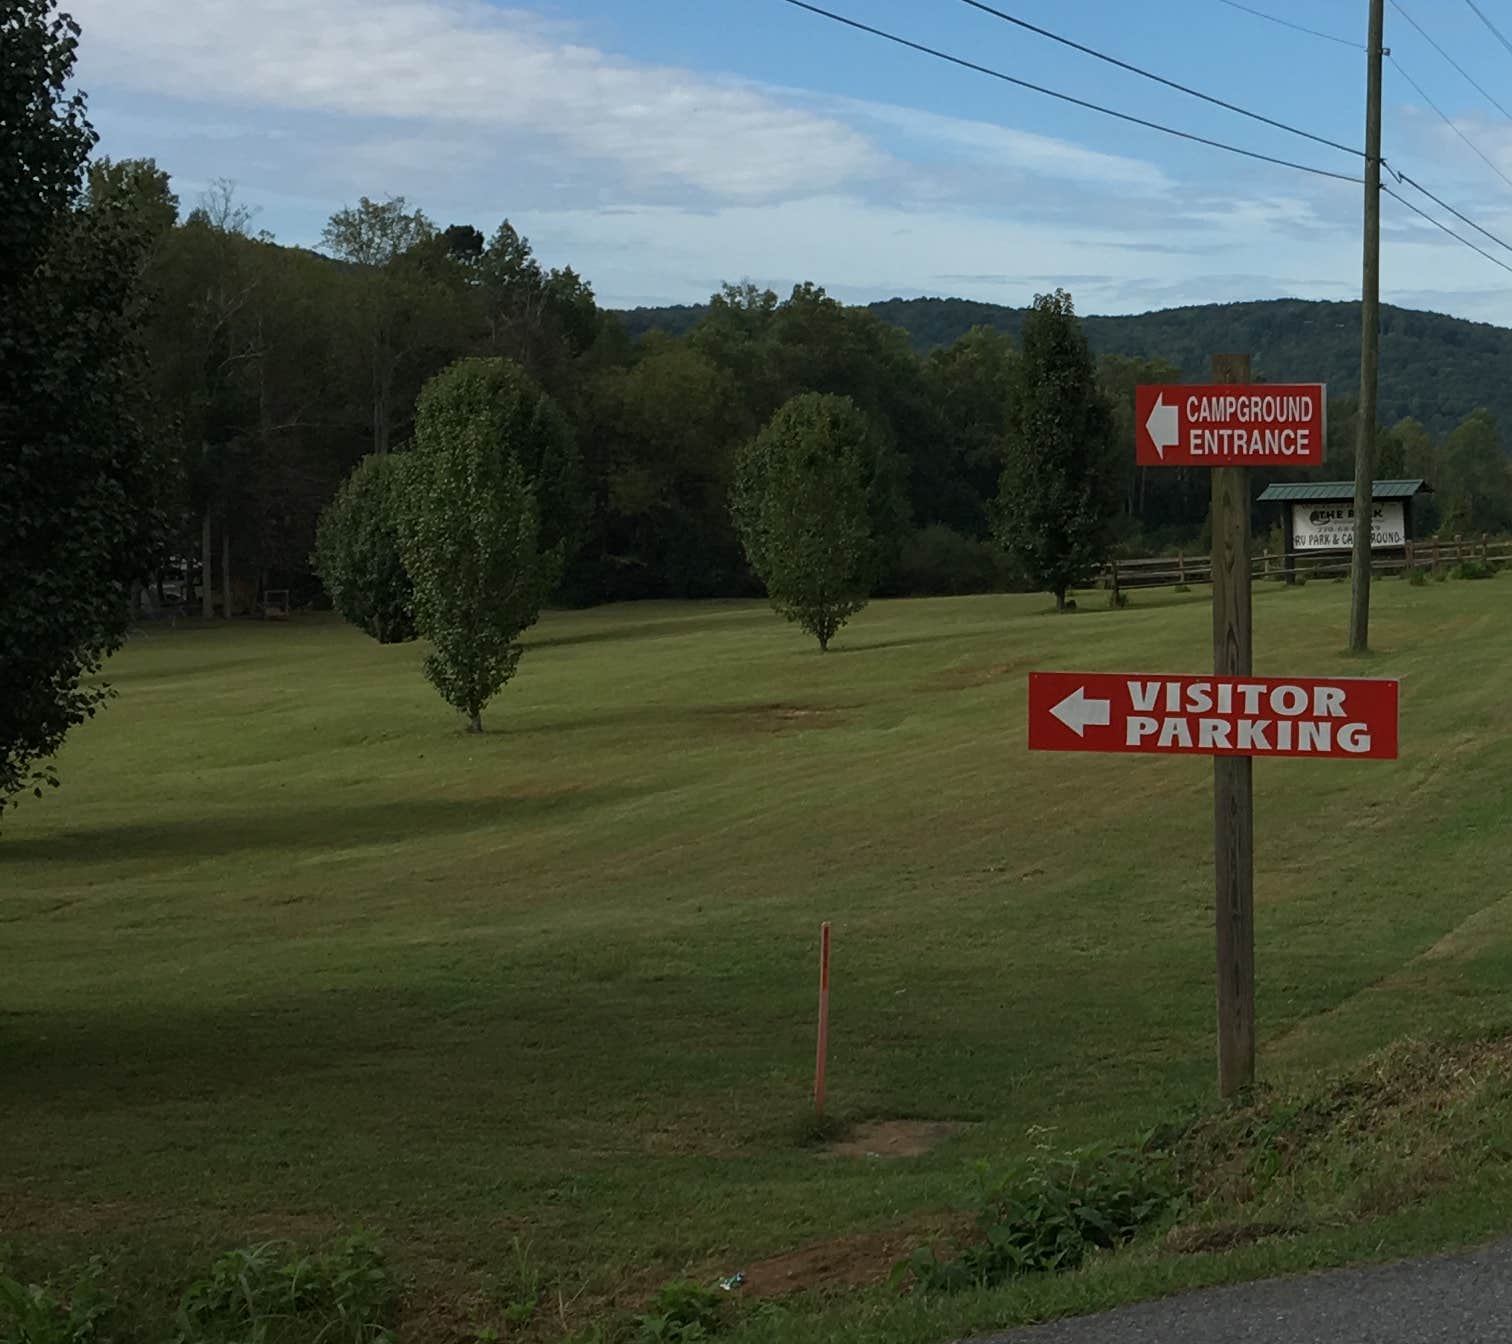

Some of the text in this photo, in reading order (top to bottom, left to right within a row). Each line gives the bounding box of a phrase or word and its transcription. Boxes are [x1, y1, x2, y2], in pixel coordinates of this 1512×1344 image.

[1186, 396, 1313, 423] CAMPGROUND
[1189, 429, 1310, 455] ENTRANCE
[1295, 535, 1306, 546] RV
[1309, 534, 1331, 546] PARK
[1333, 534, 1340, 545] &
[1127, 681, 1347, 717] VISITOR
[1125, 716, 1371, 753] PARKING
